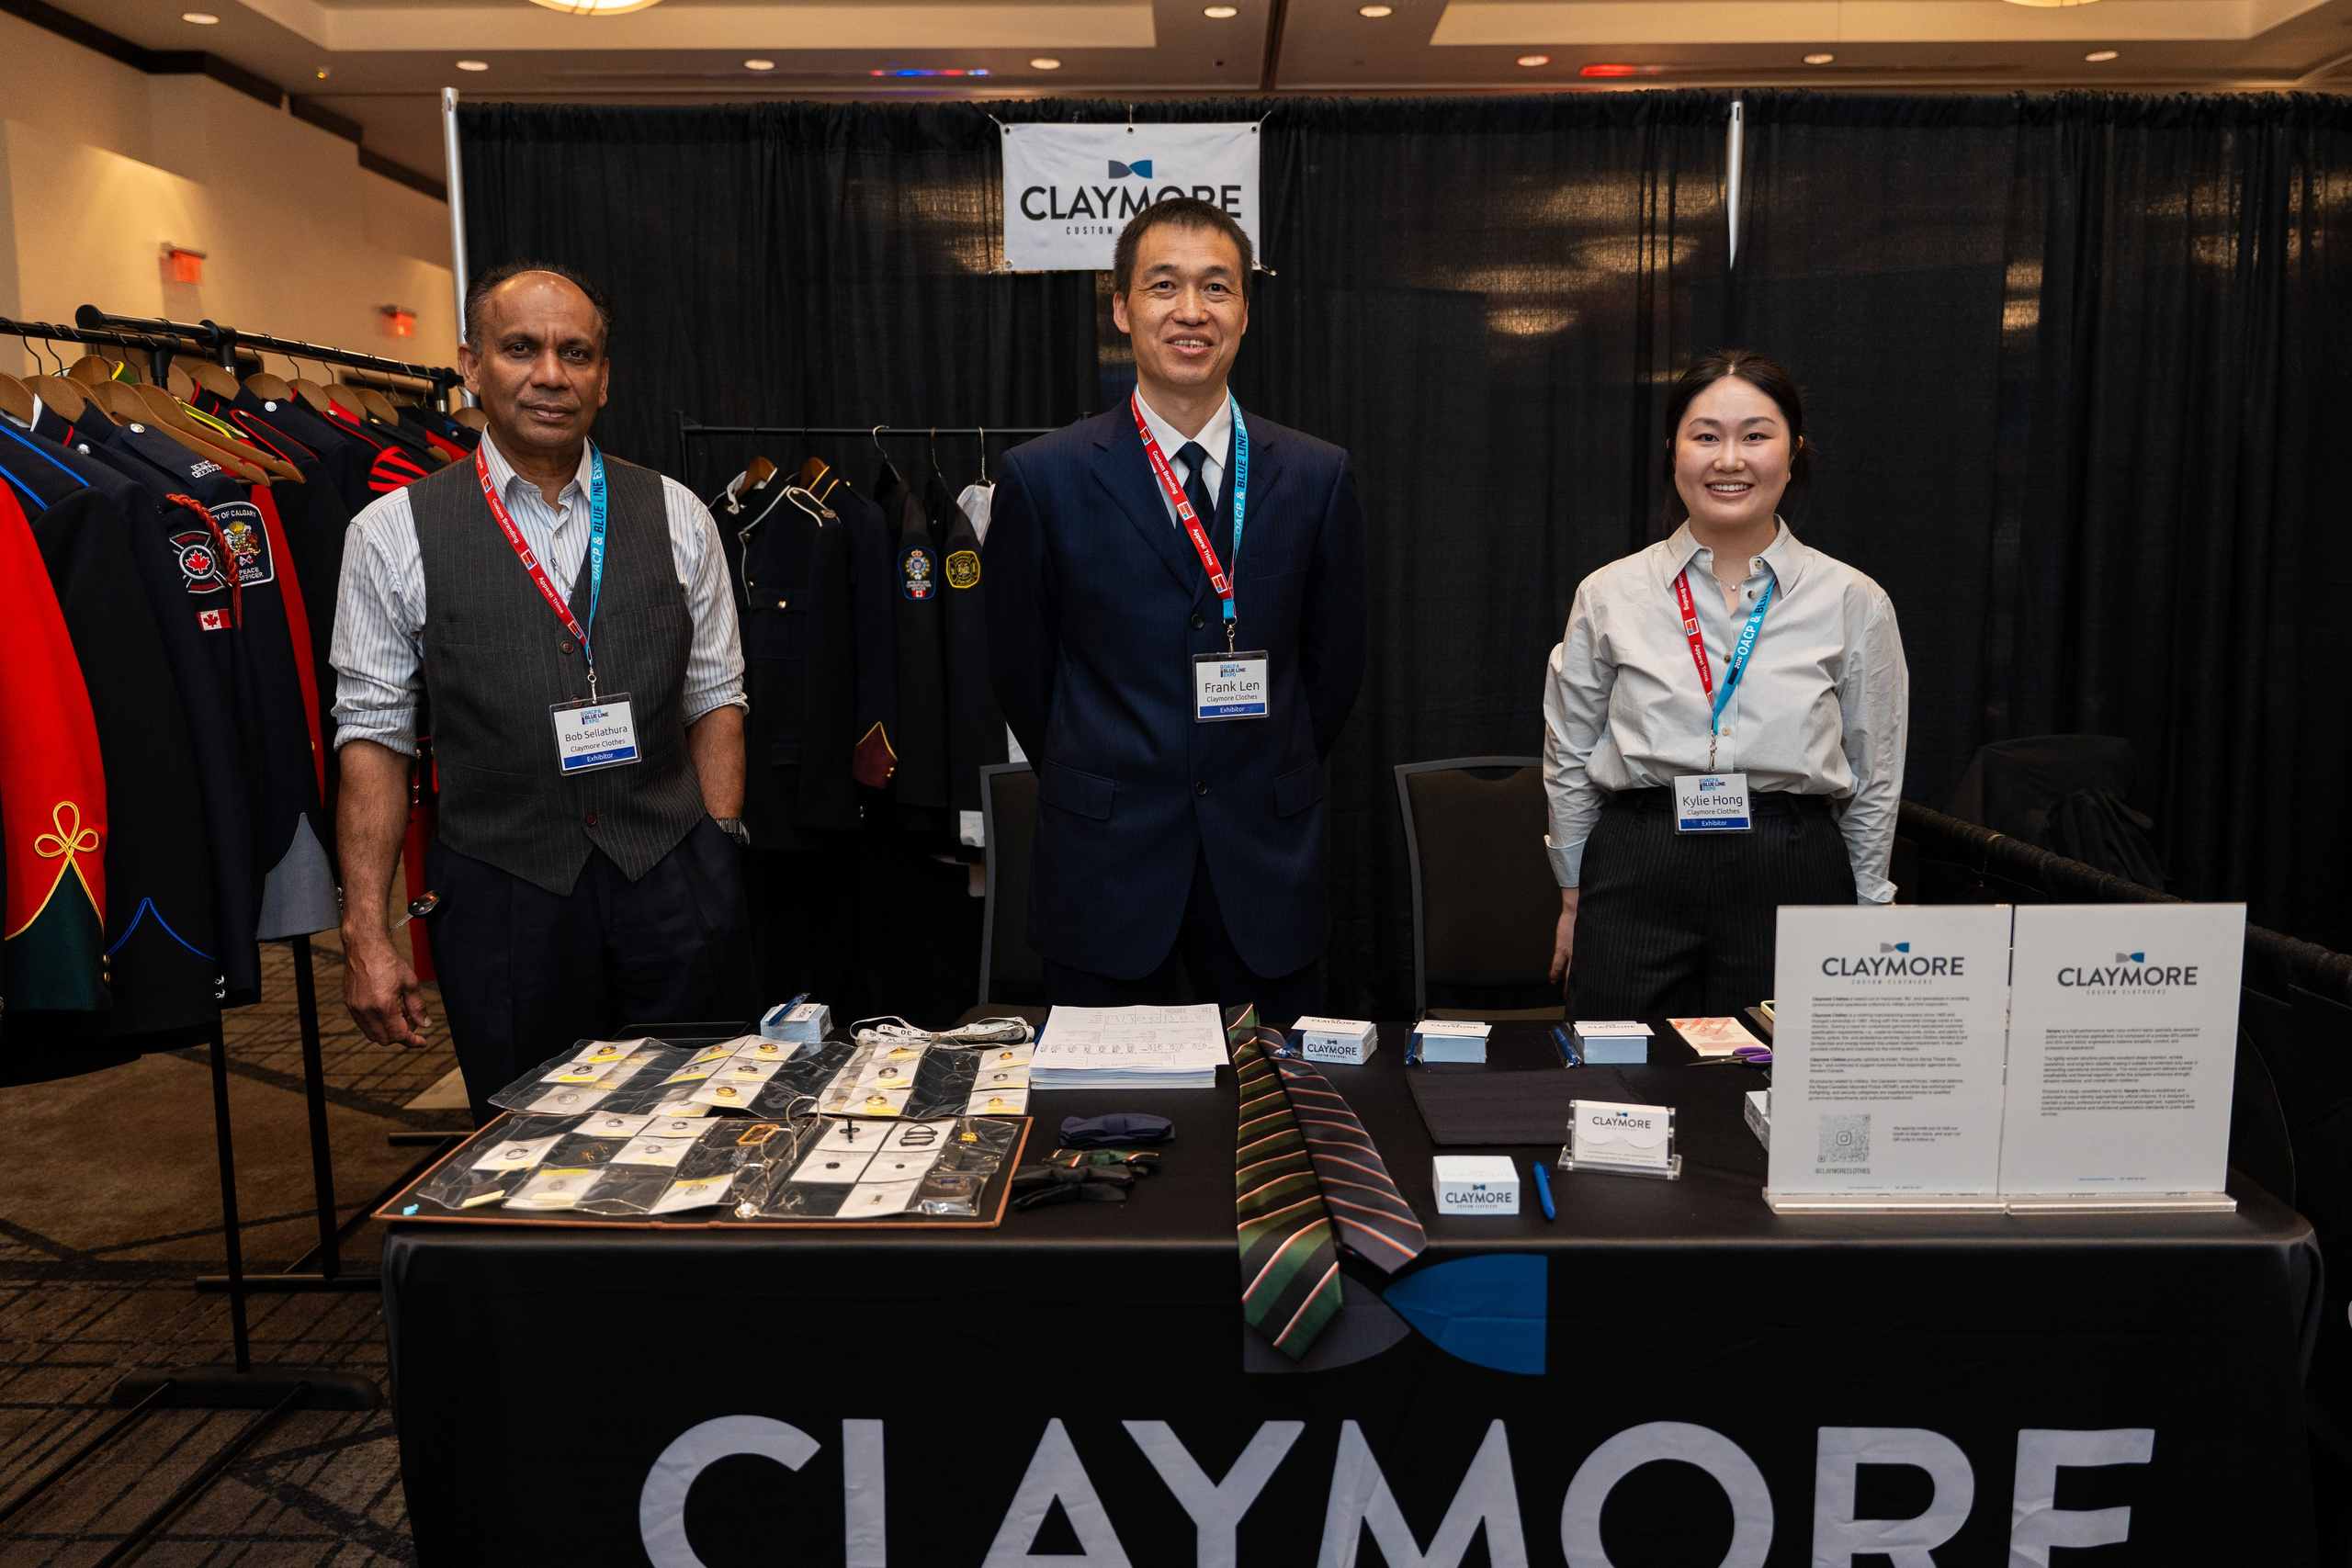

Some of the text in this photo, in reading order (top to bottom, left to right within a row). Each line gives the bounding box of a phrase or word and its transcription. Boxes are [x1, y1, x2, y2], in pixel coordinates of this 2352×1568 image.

[1066, 227, 1113, 235] CUSTOM
[1233, 403, 1245, 431] EXPO
[1238, 432, 1246, 457] LINE
[1152, 450, 1178, 494] Custom Branding
[1237, 458, 1246, 488] BLUE
[593, 481, 604, 502] LINE
[1237, 491, 1244, 500] &
[492, 498, 519, 544] Custom Branding
[594, 505, 604, 534] BLUE
[593, 536, 603, 546] &
[1193, 529, 1213, 566] Apparel Trims
[239, 567, 259, 575] PEACE
[593, 547, 602, 580] OACP
[239, 572, 264, 581] OFFICER
[538, 577, 564, 614] Apparel Trims
[1680, 589, 1690, 611] Branding
[1737, 626, 1756, 655] OACP
[1695, 644, 1704, 666] Apparel
[1735, 656, 1743, 670] 2026
[1205, 681, 1260, 693] Frank Len
[565, 726, 628, 741] Bob Sellathura
[571, 739, 626, 752] Claymore Clothes
[587, 753, 614, 761] Exhibitor
[1683, 795, 1743, 808] Kylie Hong
[1822, 956, 1964, 976] CLAYMORE
[2057, 966, 2198, 987] CLAYMORE
[1307, 1043, 1357, 1055] CLAYMORE
[1592, 1116, 1651, 1129] CLAYMORE
[1445, 1192, 1512, 1203] CLAYMORE
[639, 1416, 2154, 1568] CLAYMORE
